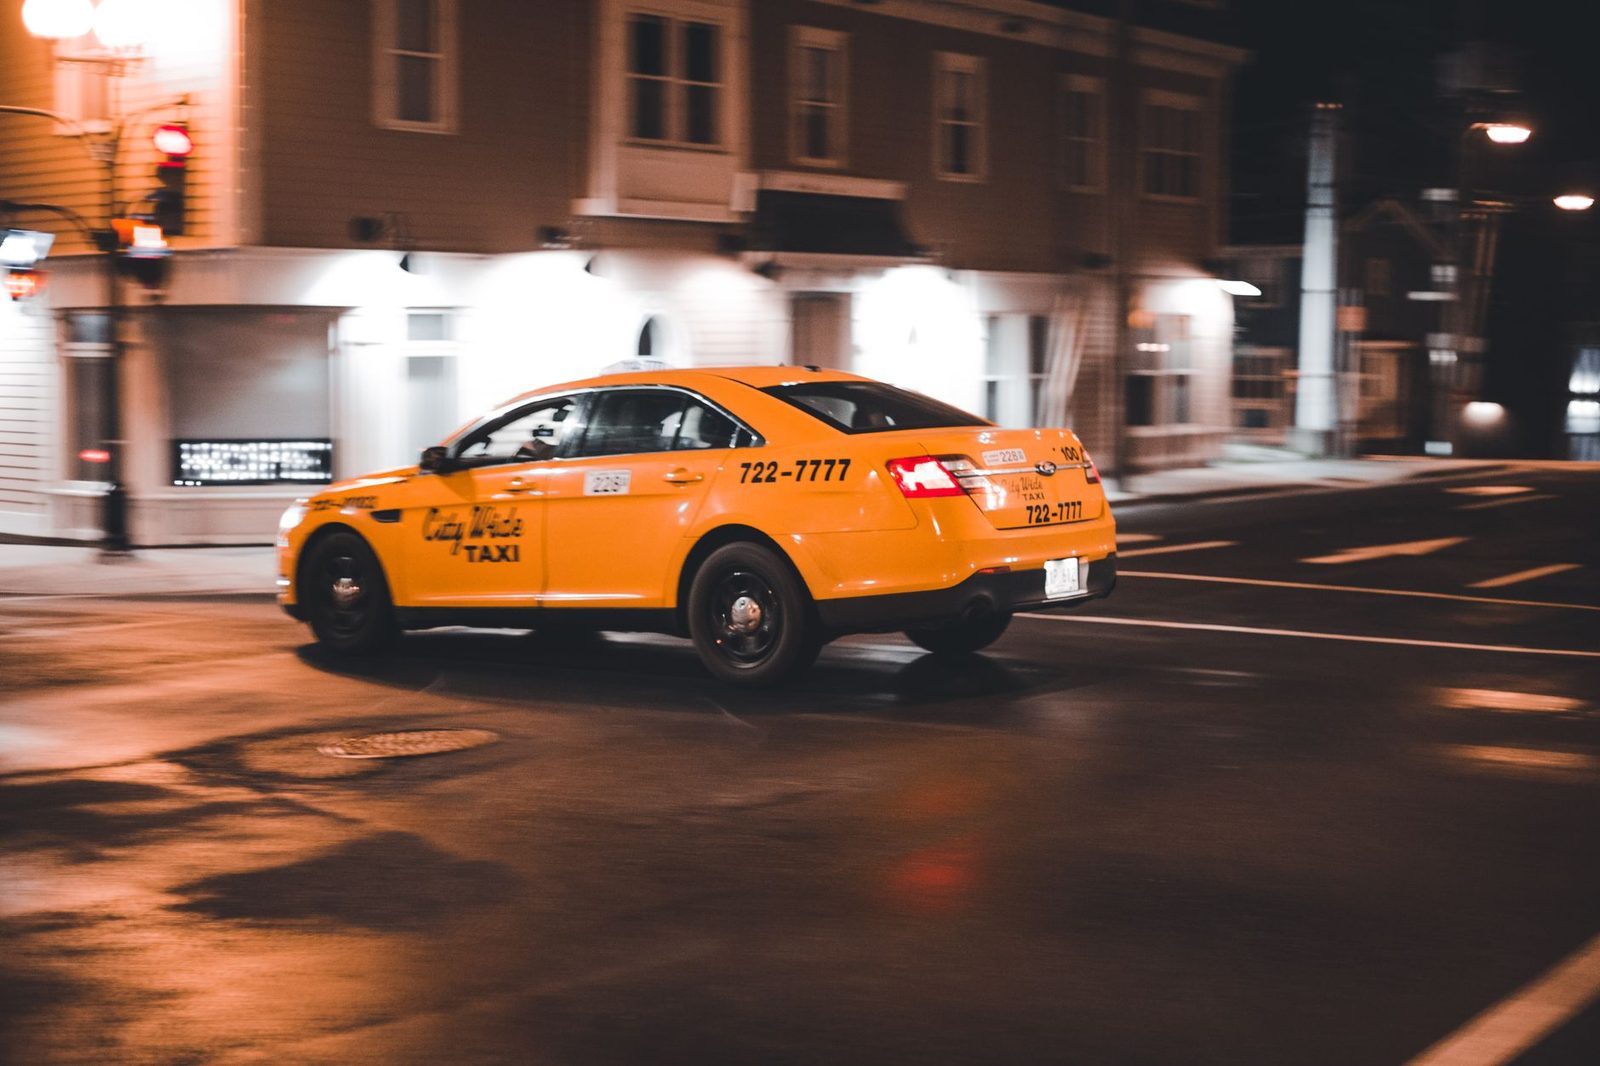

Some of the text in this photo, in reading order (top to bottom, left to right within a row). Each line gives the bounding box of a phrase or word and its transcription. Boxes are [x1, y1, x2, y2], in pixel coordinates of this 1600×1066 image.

[1060, 446, 1080, 461] 100
[741, 459, 851, 484] 722-7777
[1022, 492, 1045, 501] TAXI
[1026, 501, 1082, 524] 722-7777
[464, 545, 520, 563] TAXI
